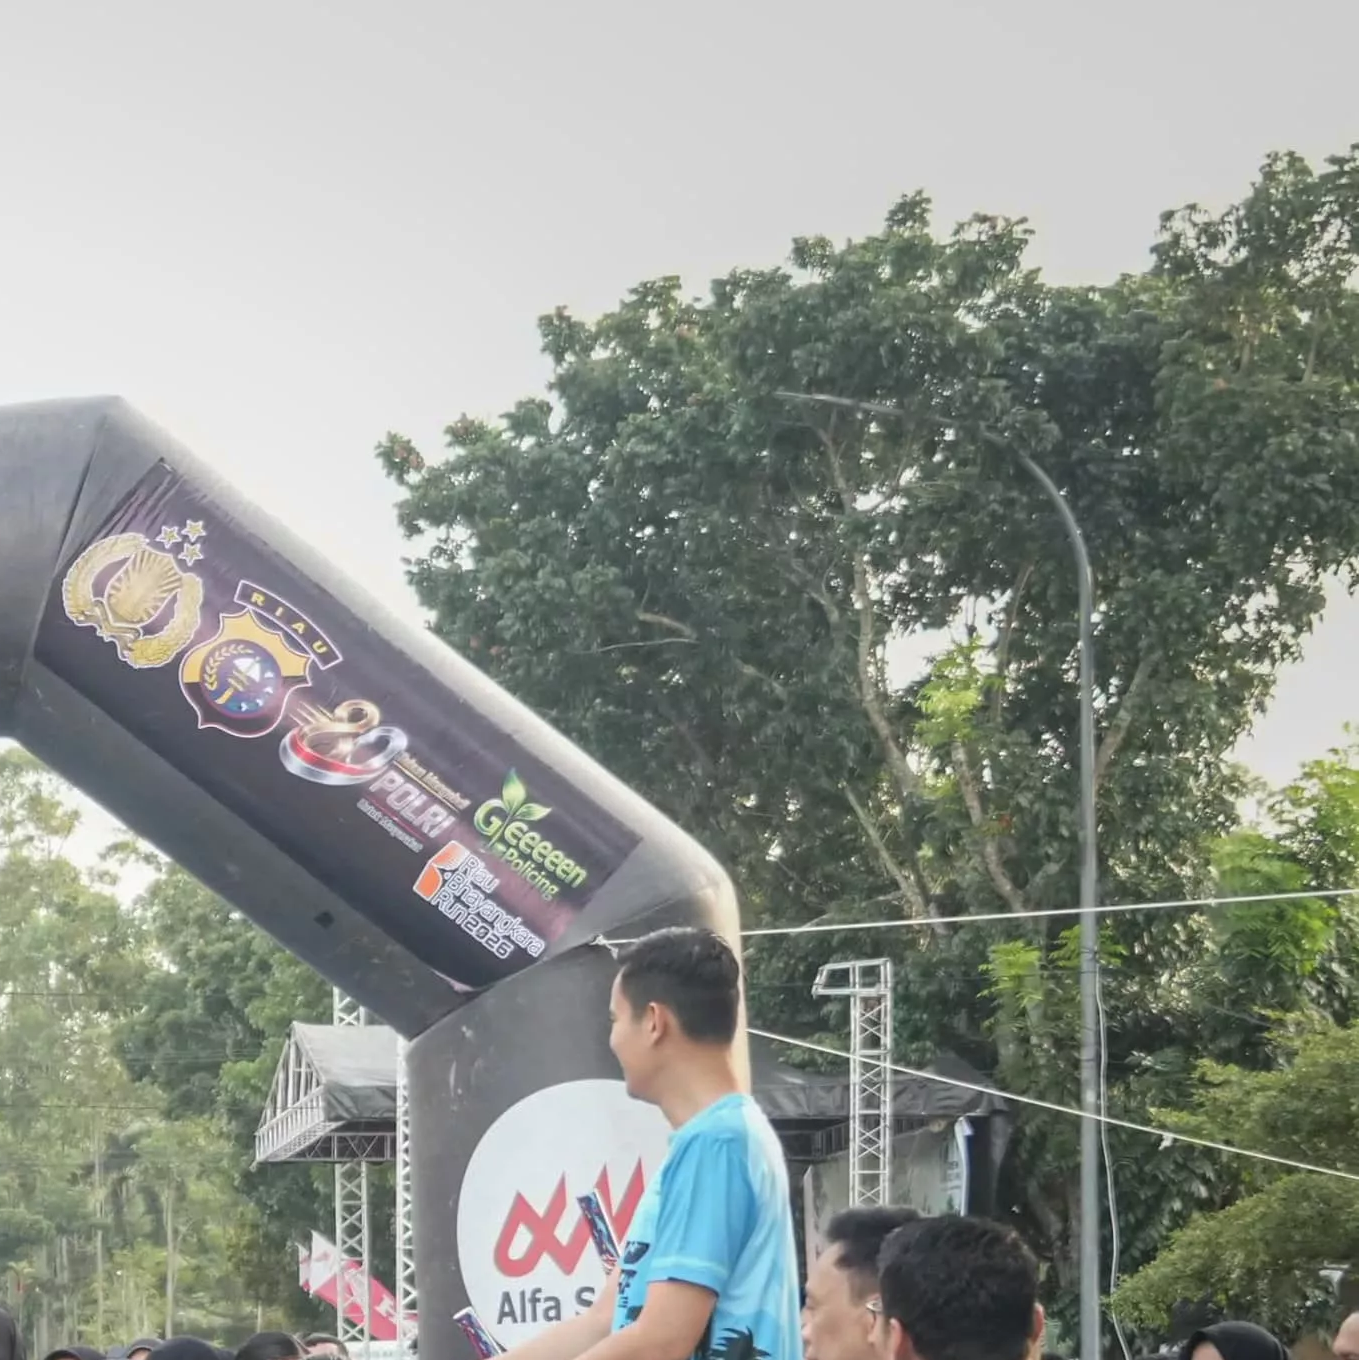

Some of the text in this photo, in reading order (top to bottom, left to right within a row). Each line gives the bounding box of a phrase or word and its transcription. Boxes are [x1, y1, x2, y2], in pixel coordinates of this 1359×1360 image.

[251, 591, 328, 654] RIAU
[368, 769, 456, 838] POLRI
[457, 853, 501, 894] Riau
[502, 847, 561, 901] Policing
[432, 886, 515, 960] Run 2026
[446, 872, 546, 958] Bhayangkara
[496, 1286, 562, 1325] Alfa
